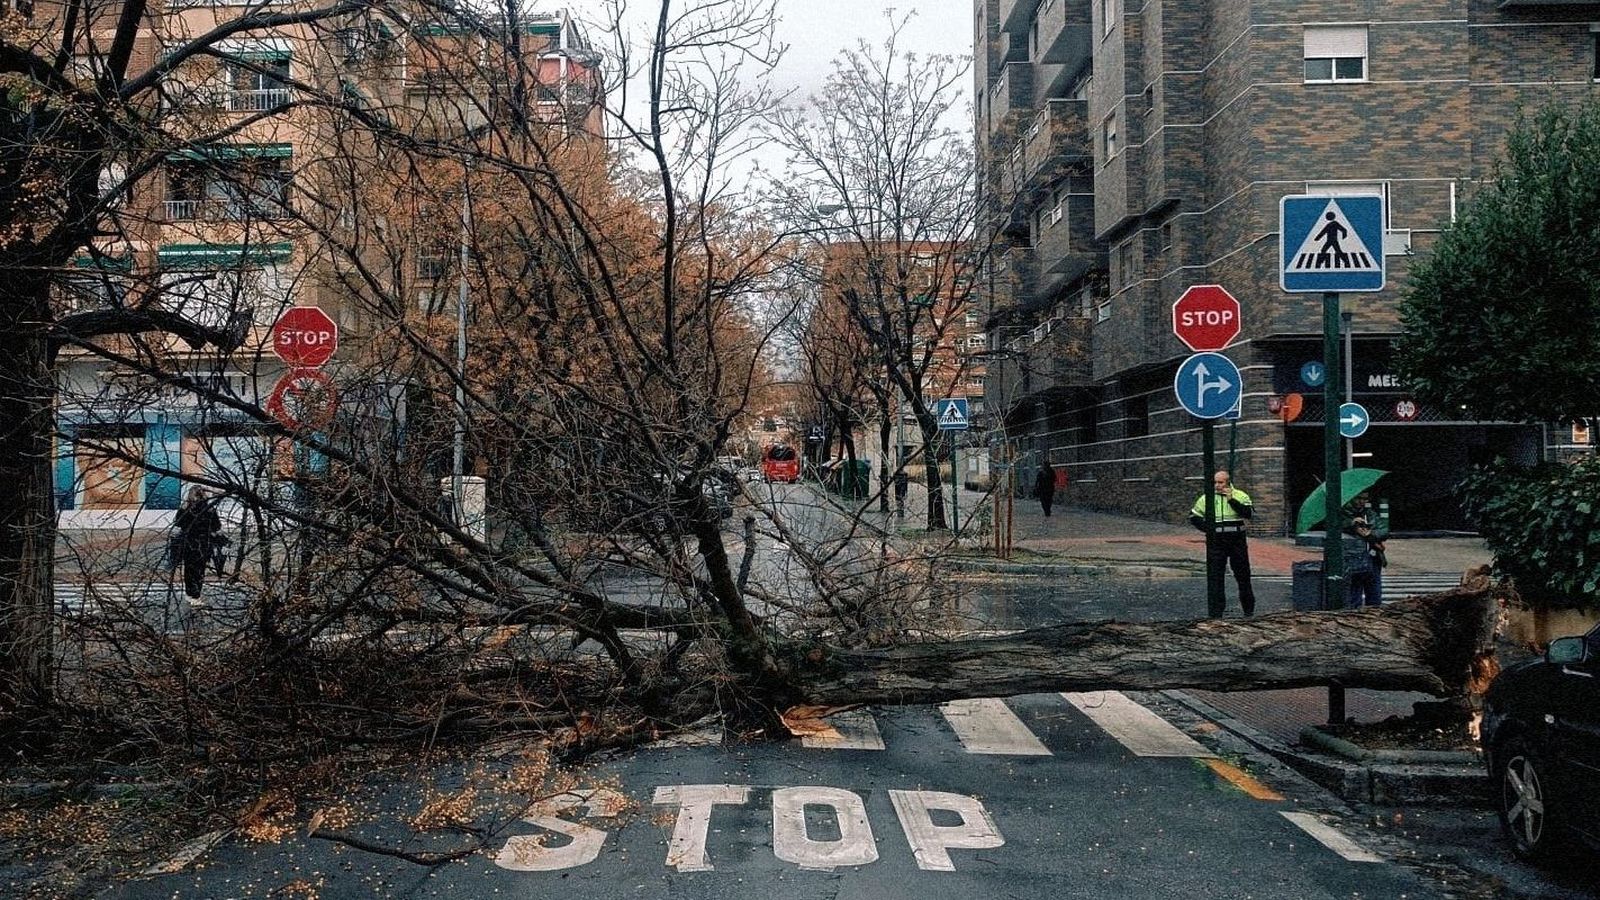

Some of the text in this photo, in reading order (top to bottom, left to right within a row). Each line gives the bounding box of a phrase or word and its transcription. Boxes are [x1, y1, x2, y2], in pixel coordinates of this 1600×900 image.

[1181, 310, 1233, 326] STOP
[280, 331, 330, 345] STOP
[494, 786, 1006, 872] STOP
